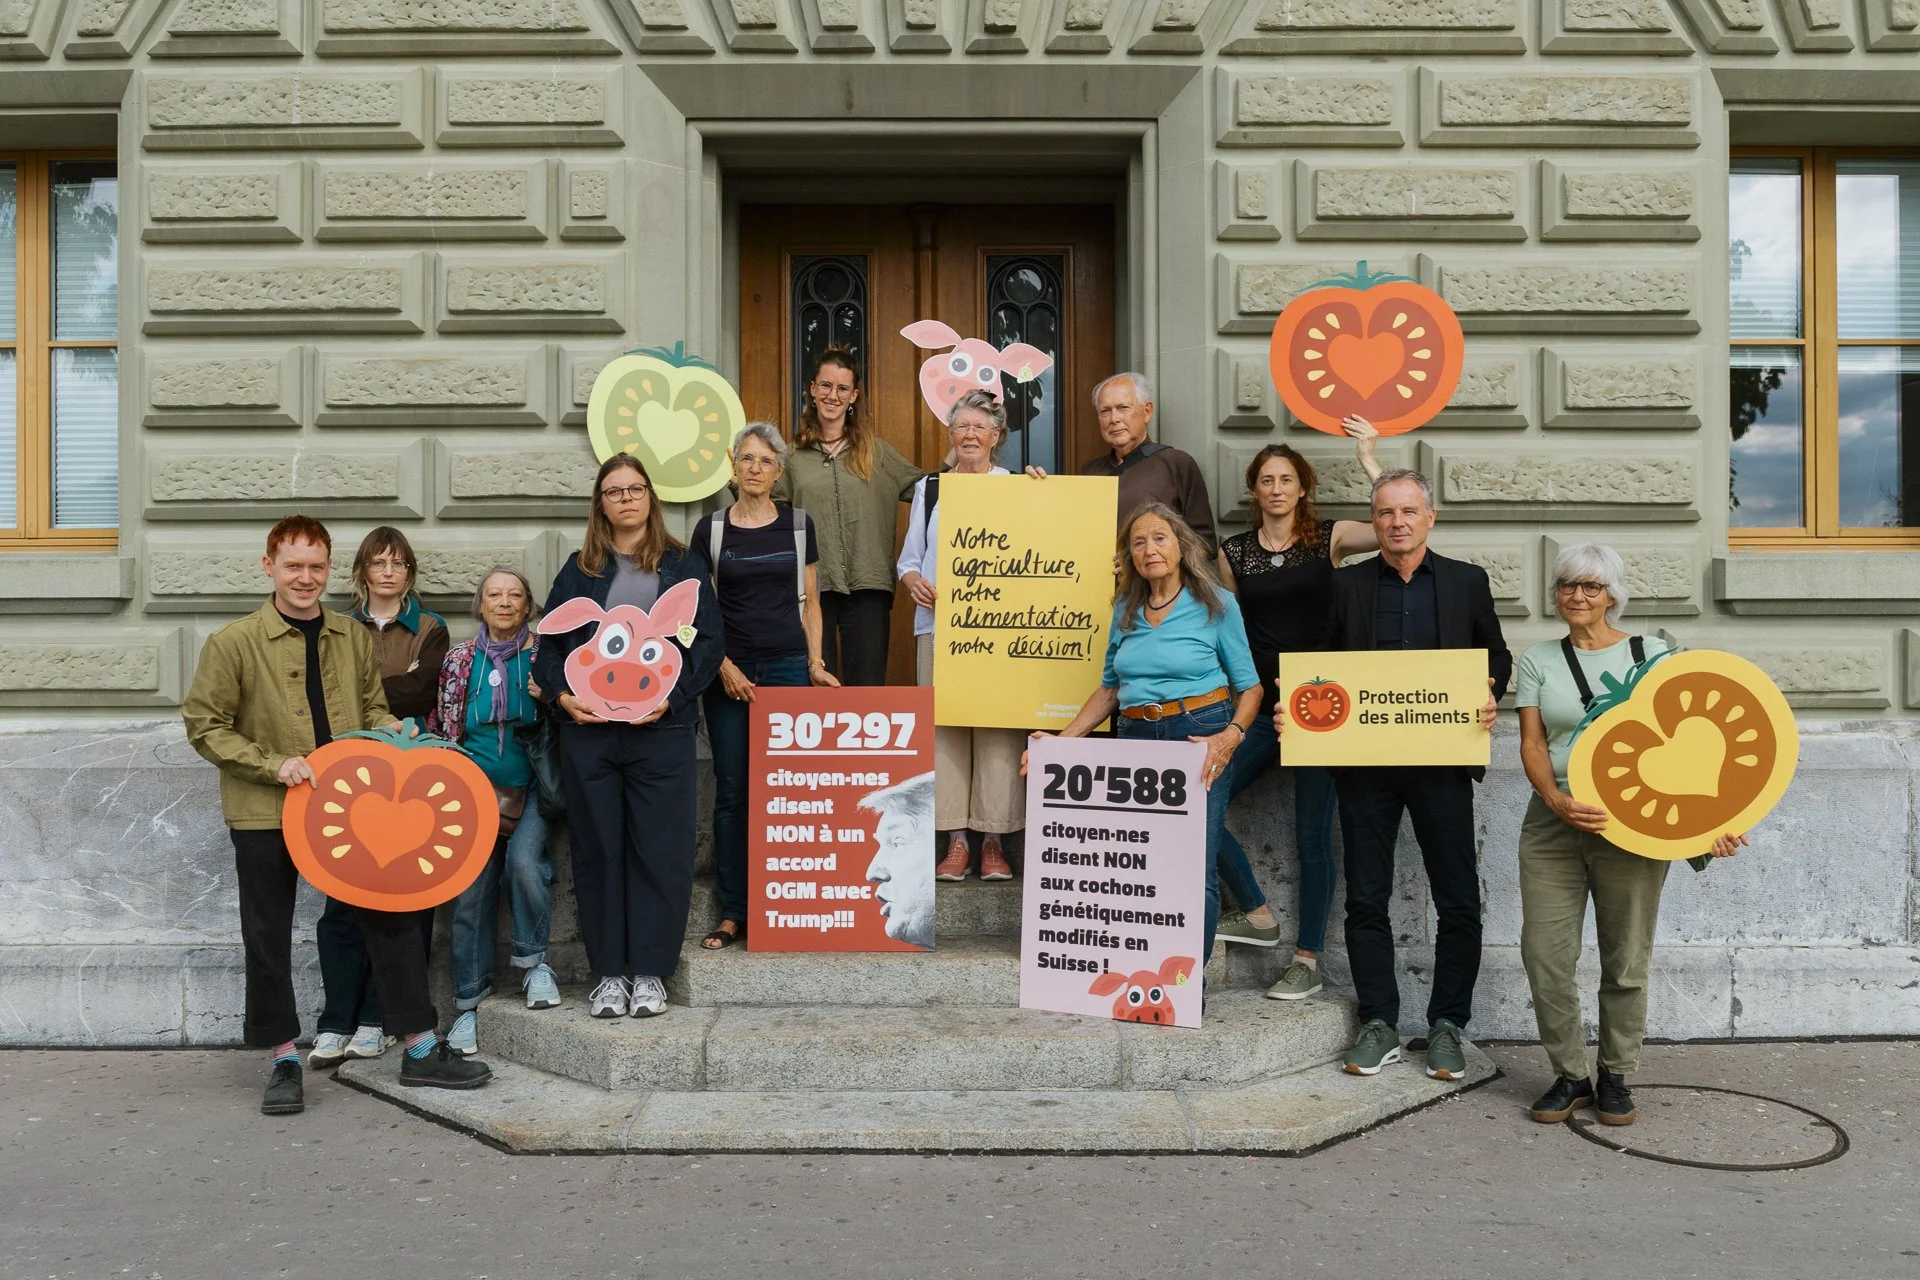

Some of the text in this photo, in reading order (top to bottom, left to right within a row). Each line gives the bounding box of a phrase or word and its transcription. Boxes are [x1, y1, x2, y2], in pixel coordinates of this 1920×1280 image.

[950, 527, 1010, 550] Notre
[952, 549, 1081, 587] agriculture,
[951, 584, 1001, 603] notre
[951, 605, 1099, 633] alimentation,
[949, 636, 994, 655] notre
[1359, 689, 1449, 704] Protection
[1359, 710, 1389, 724] des
[1394, 709, 1469, 724] aliments
[767, 712, 916, 749] 30'297
[1043, 763, 1187, 807] 20'588
[766, 797, 834, 815] disent
[766, 824, 865, 843] NON à un
[765, 853, 837, 872] accord
[1041, 848, 1147, 870] disent NON
[766, 882, 871, 900] OGM avec
[1040, 876, 1156, 898] aux cochons
[765, 910, 855, 933] Trump!!!
[1040, 900, 1184, 928] génétiquement
[1038, 928, 1148, 952] modifiés en
[1038, 952, 1098, 973] Suisse
